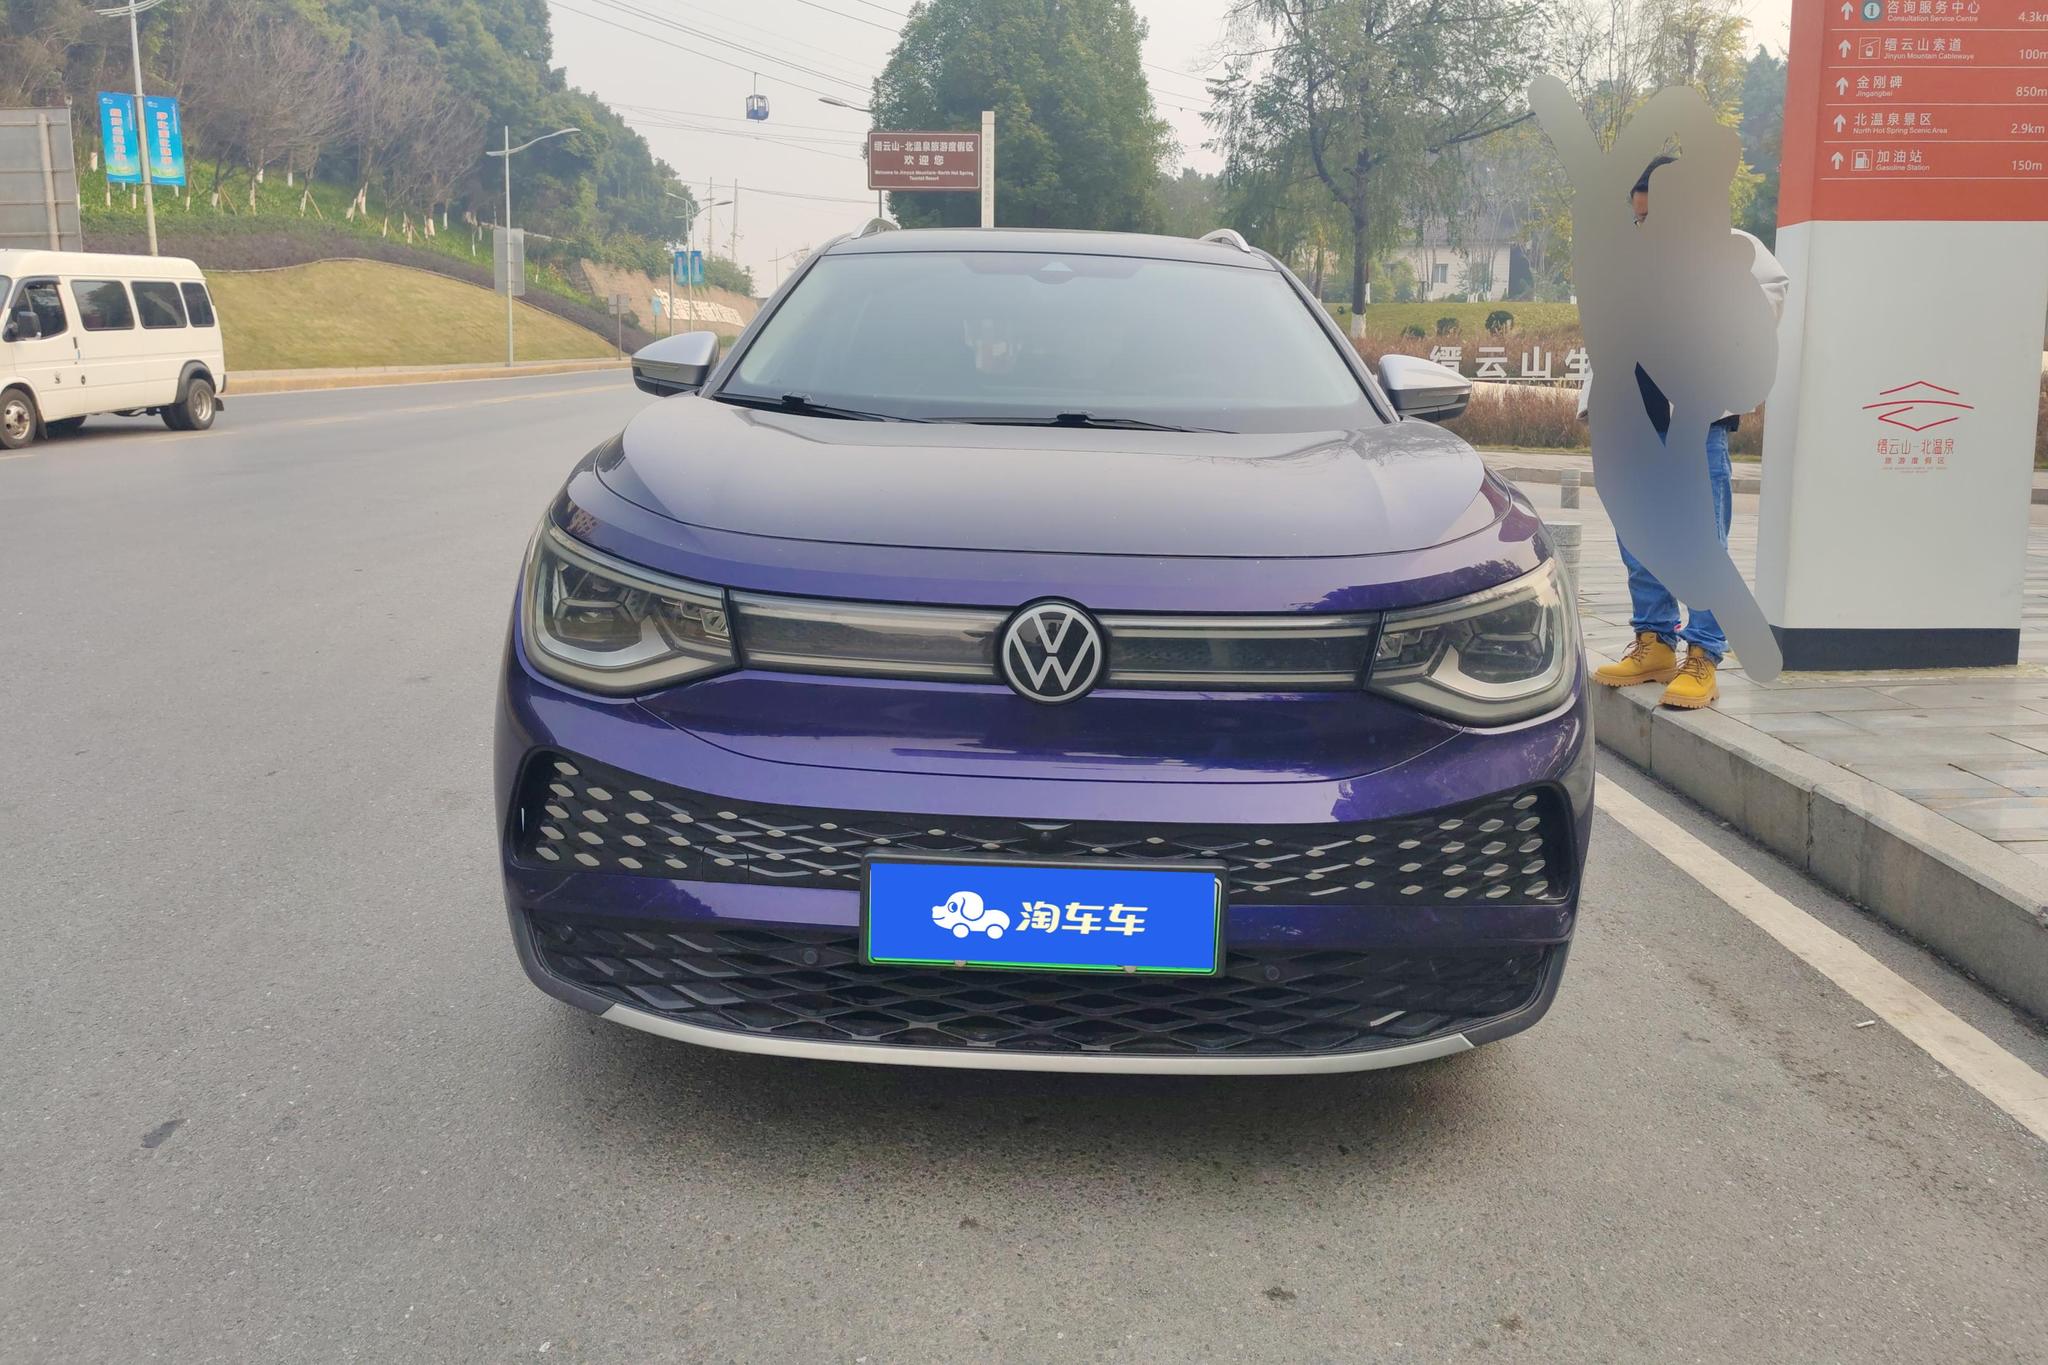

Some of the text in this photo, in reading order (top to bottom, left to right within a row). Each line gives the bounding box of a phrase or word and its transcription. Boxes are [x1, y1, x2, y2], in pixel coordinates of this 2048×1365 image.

[1887, 0, 1981, 15] 咨询服务中心
[1887, 14, 1929, 22] Consultation
[1884, 37, 1962, 52] 缙云山索道
[1884, 53, 1906, 61] Jinyun
[2018, 49, 2048, 60] 100m
[1856, 75, 1903, 89] 金刚碑
[2015, 86, 2048, 97] 850m
[1854, 112, 1933, 126] 北温泉景区
[1886, 127, 1908, 135] Spring
[2010, 123, 2045, 134] 2.9km
[903, 155, 944, 166] 欢迎您
[1875, 149, 1923, 163] 加油站
[2011, 160, 2042, 171] 150m
